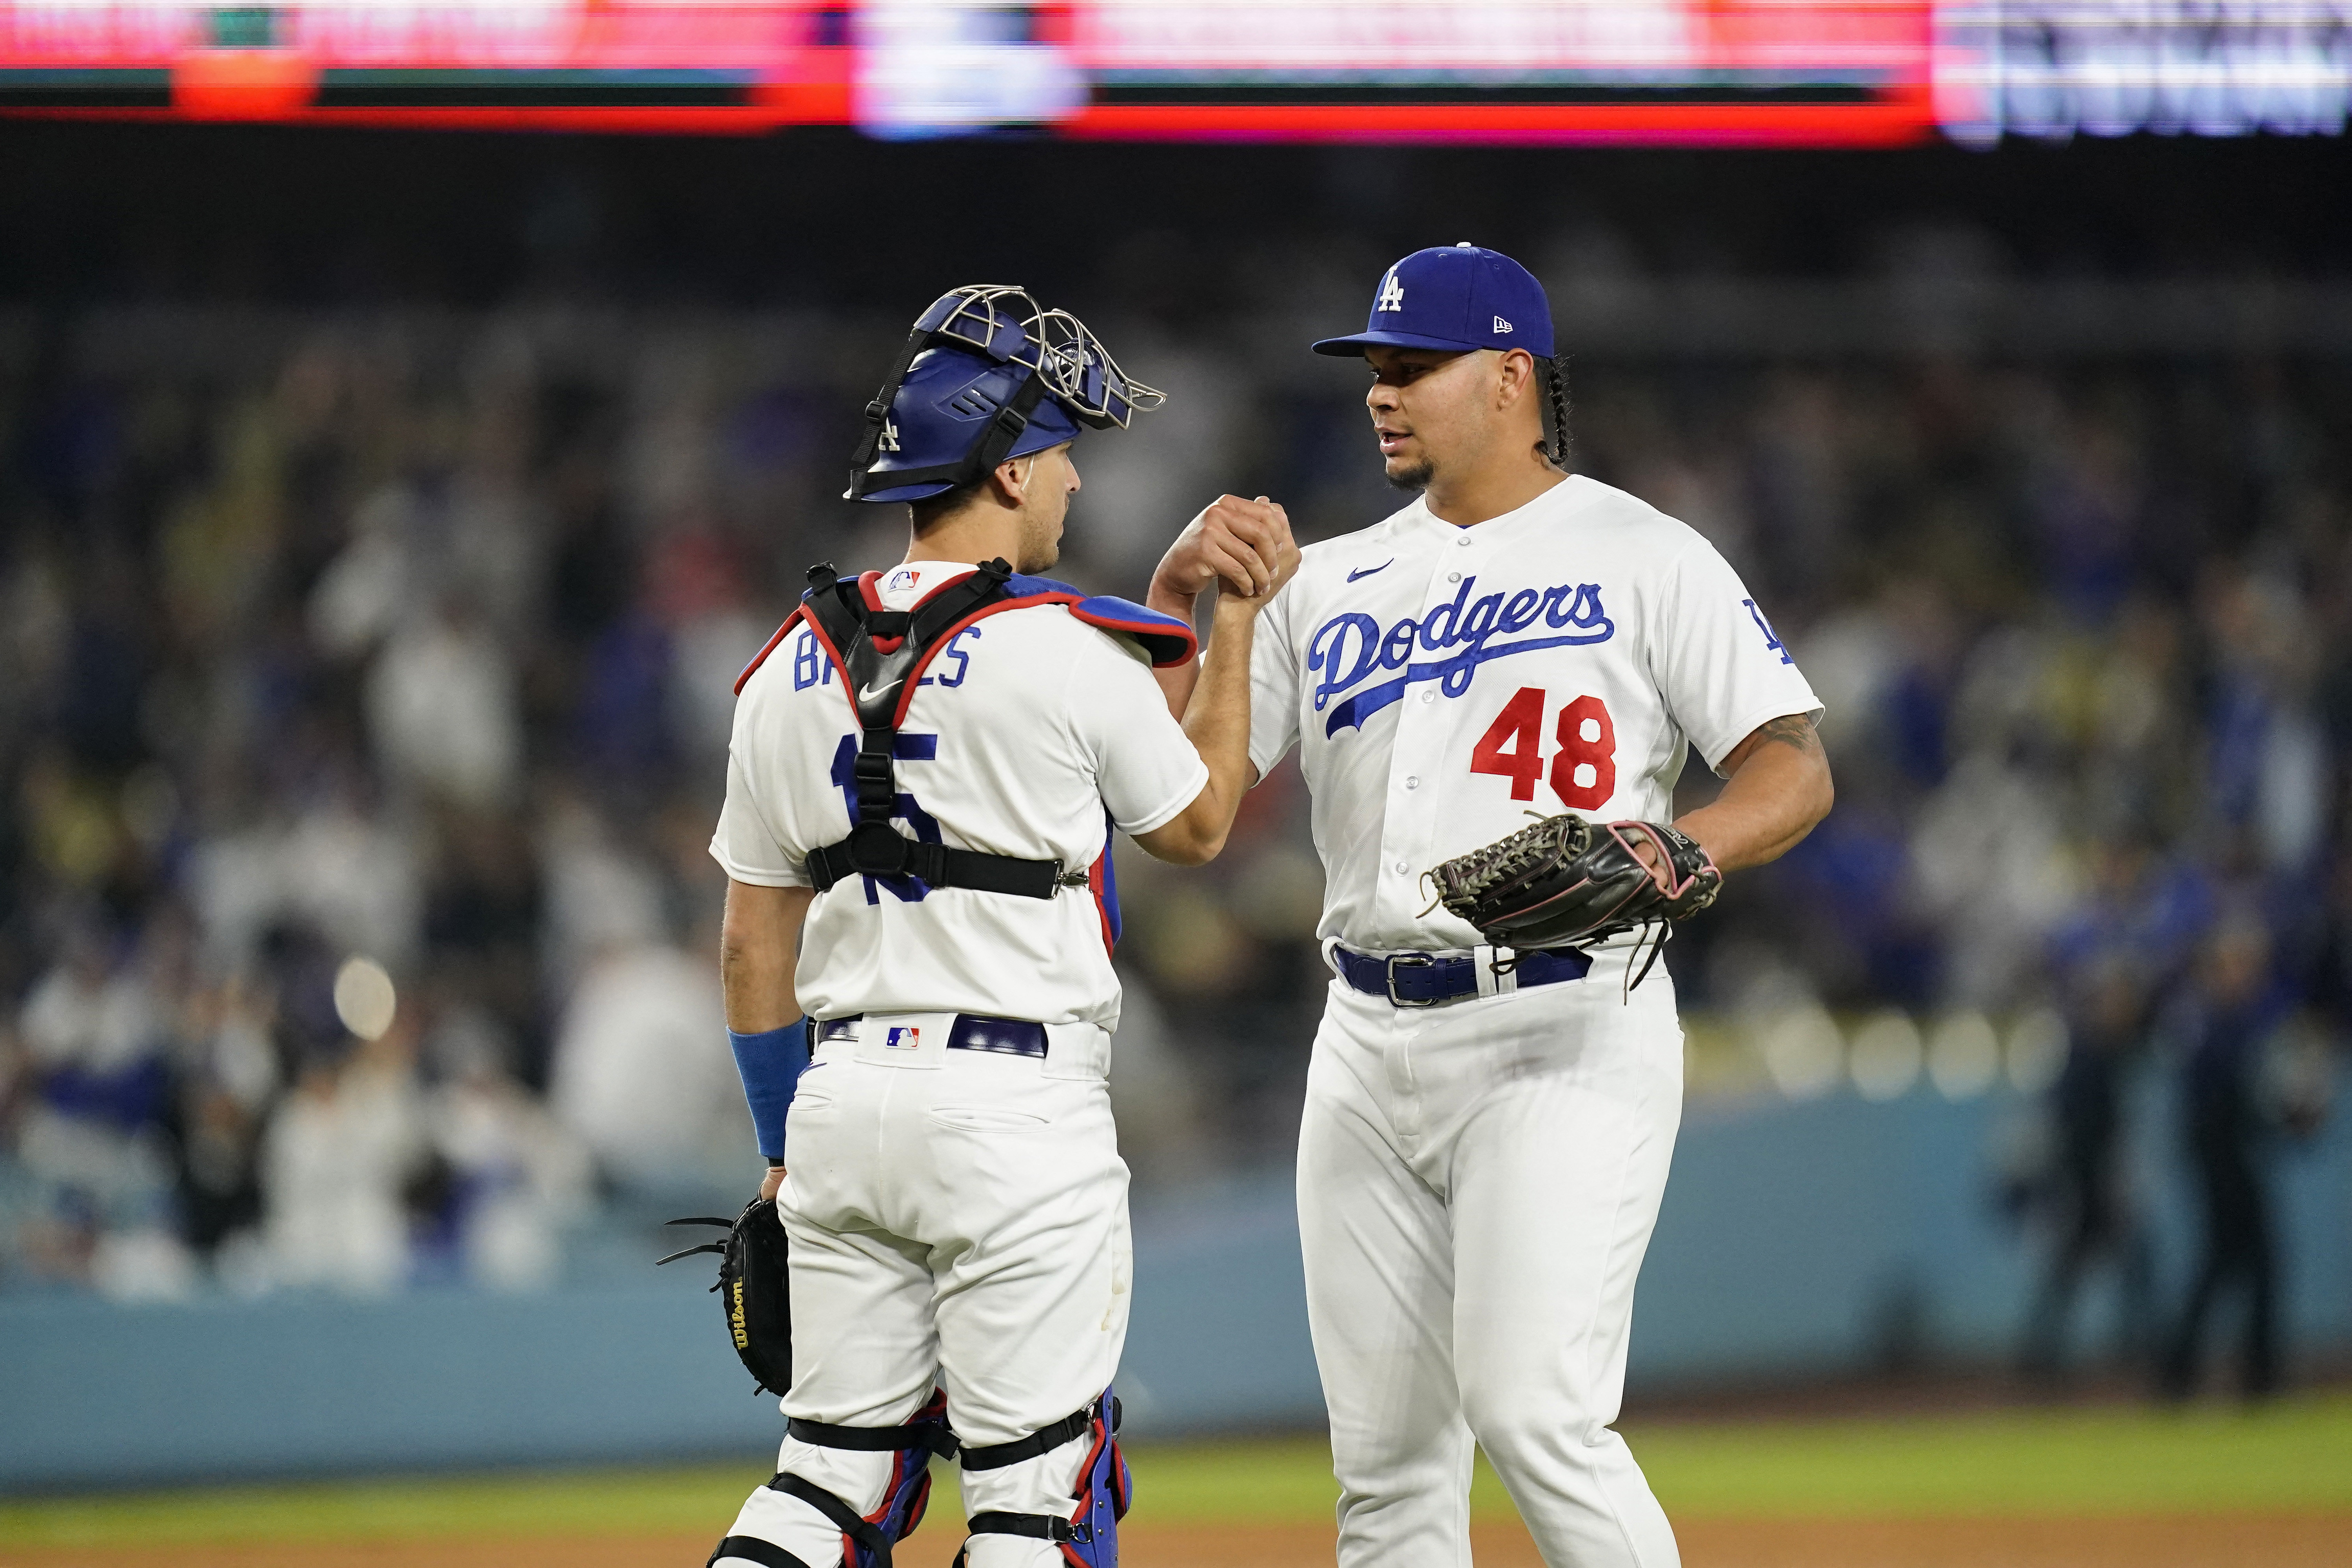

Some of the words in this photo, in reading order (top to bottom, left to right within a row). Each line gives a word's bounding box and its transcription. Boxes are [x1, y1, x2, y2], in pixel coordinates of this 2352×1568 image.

[1378, 265, 1404, 312] LA
[1308, 575, 1614, 712] Dodgers
[1470, 686, 1616, 811] 48
[731, 1280, 749, 1350] Wilson
